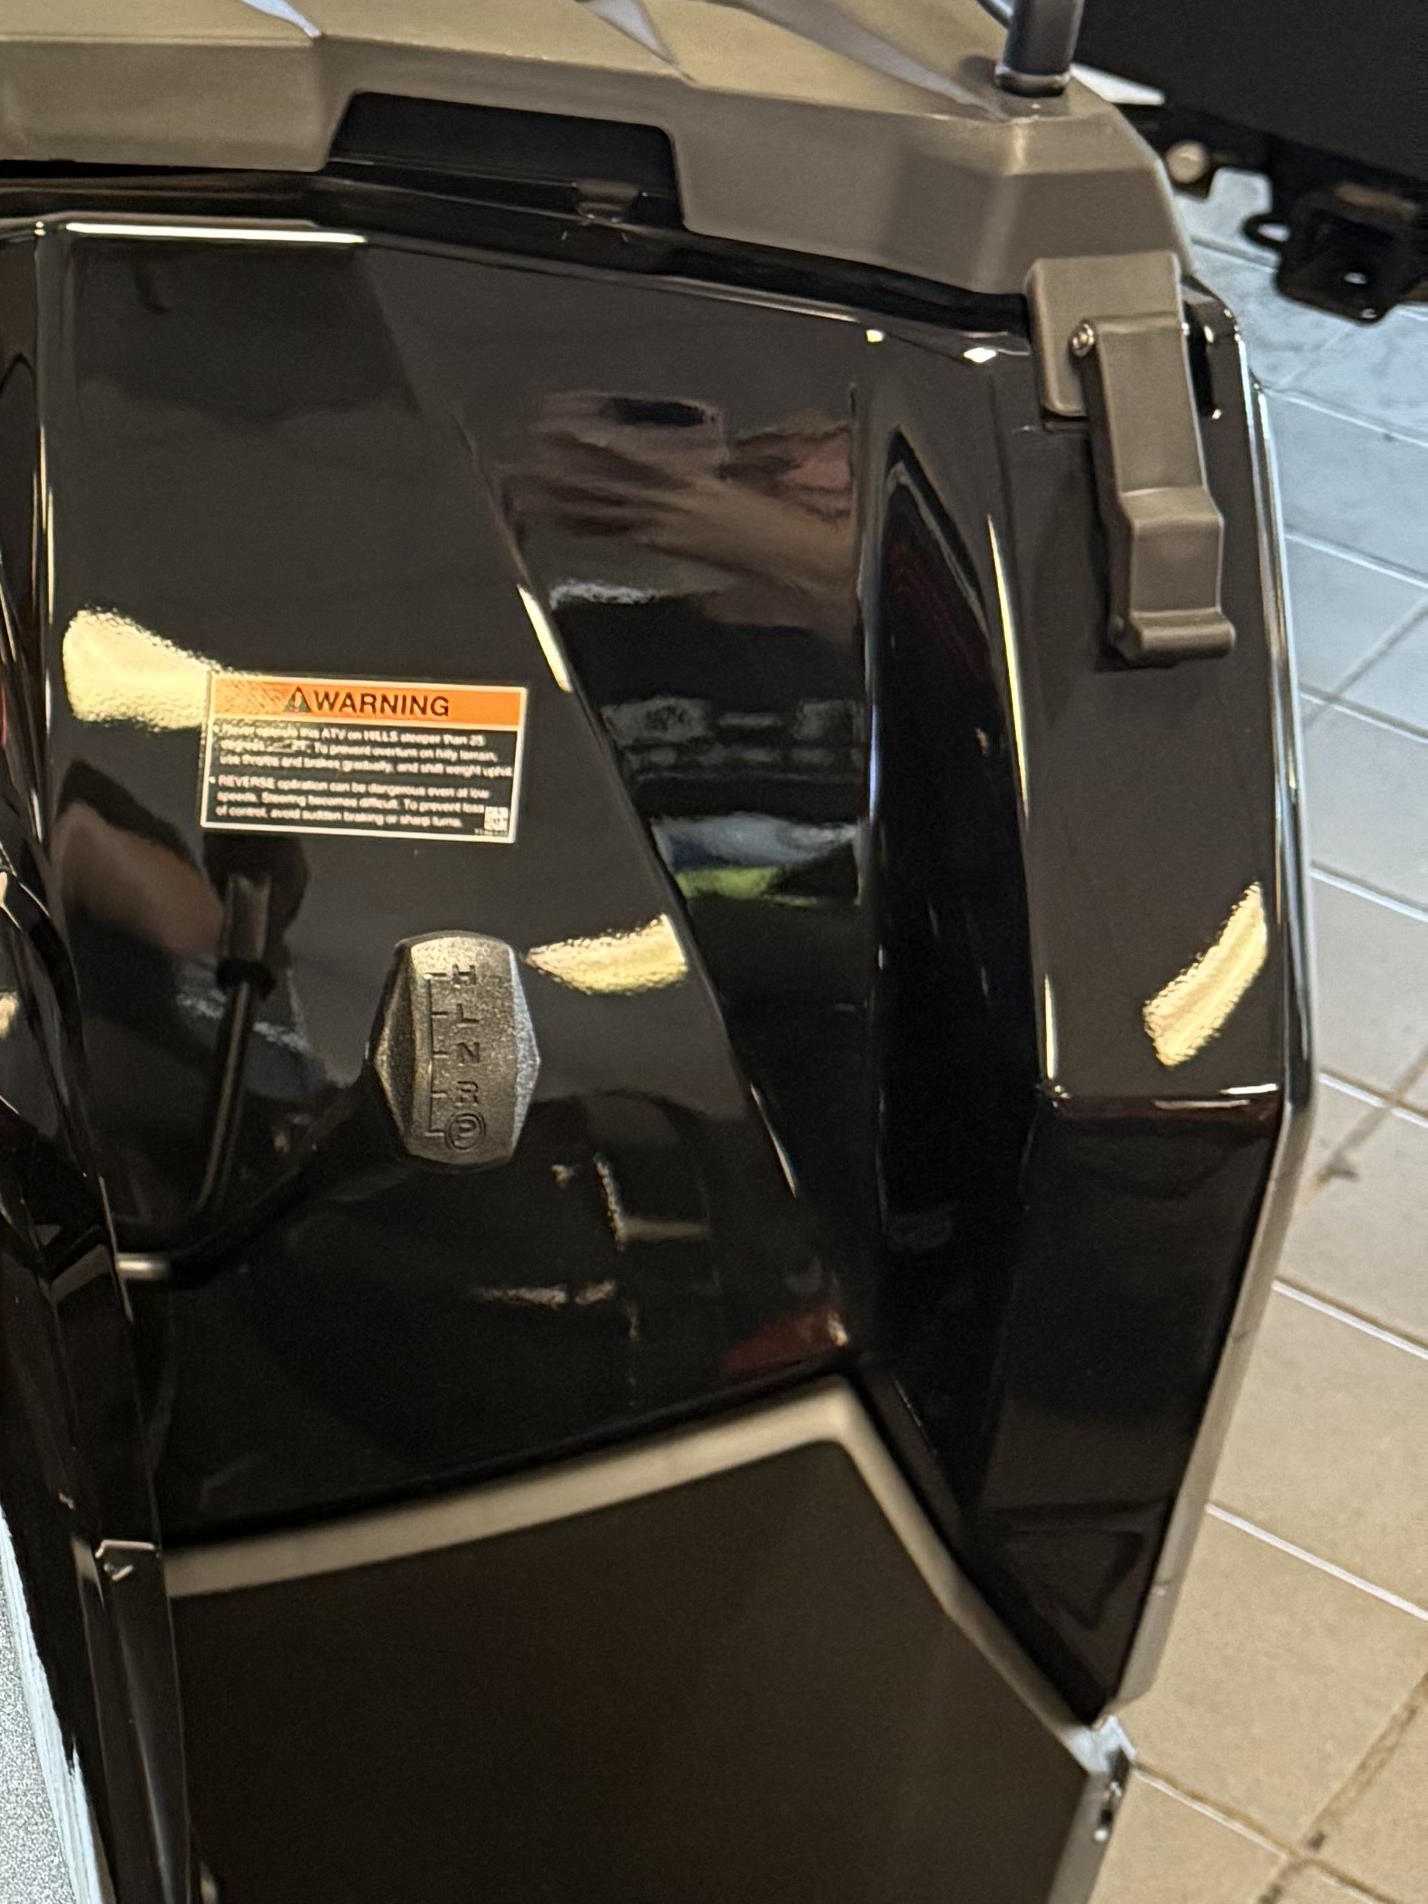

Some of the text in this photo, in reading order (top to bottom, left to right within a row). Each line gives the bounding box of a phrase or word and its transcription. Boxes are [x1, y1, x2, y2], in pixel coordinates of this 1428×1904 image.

[313, 690, 449, 717] WARNING
[452, 964, 476, 985] H
[457, 1042, 480, 1063] N
